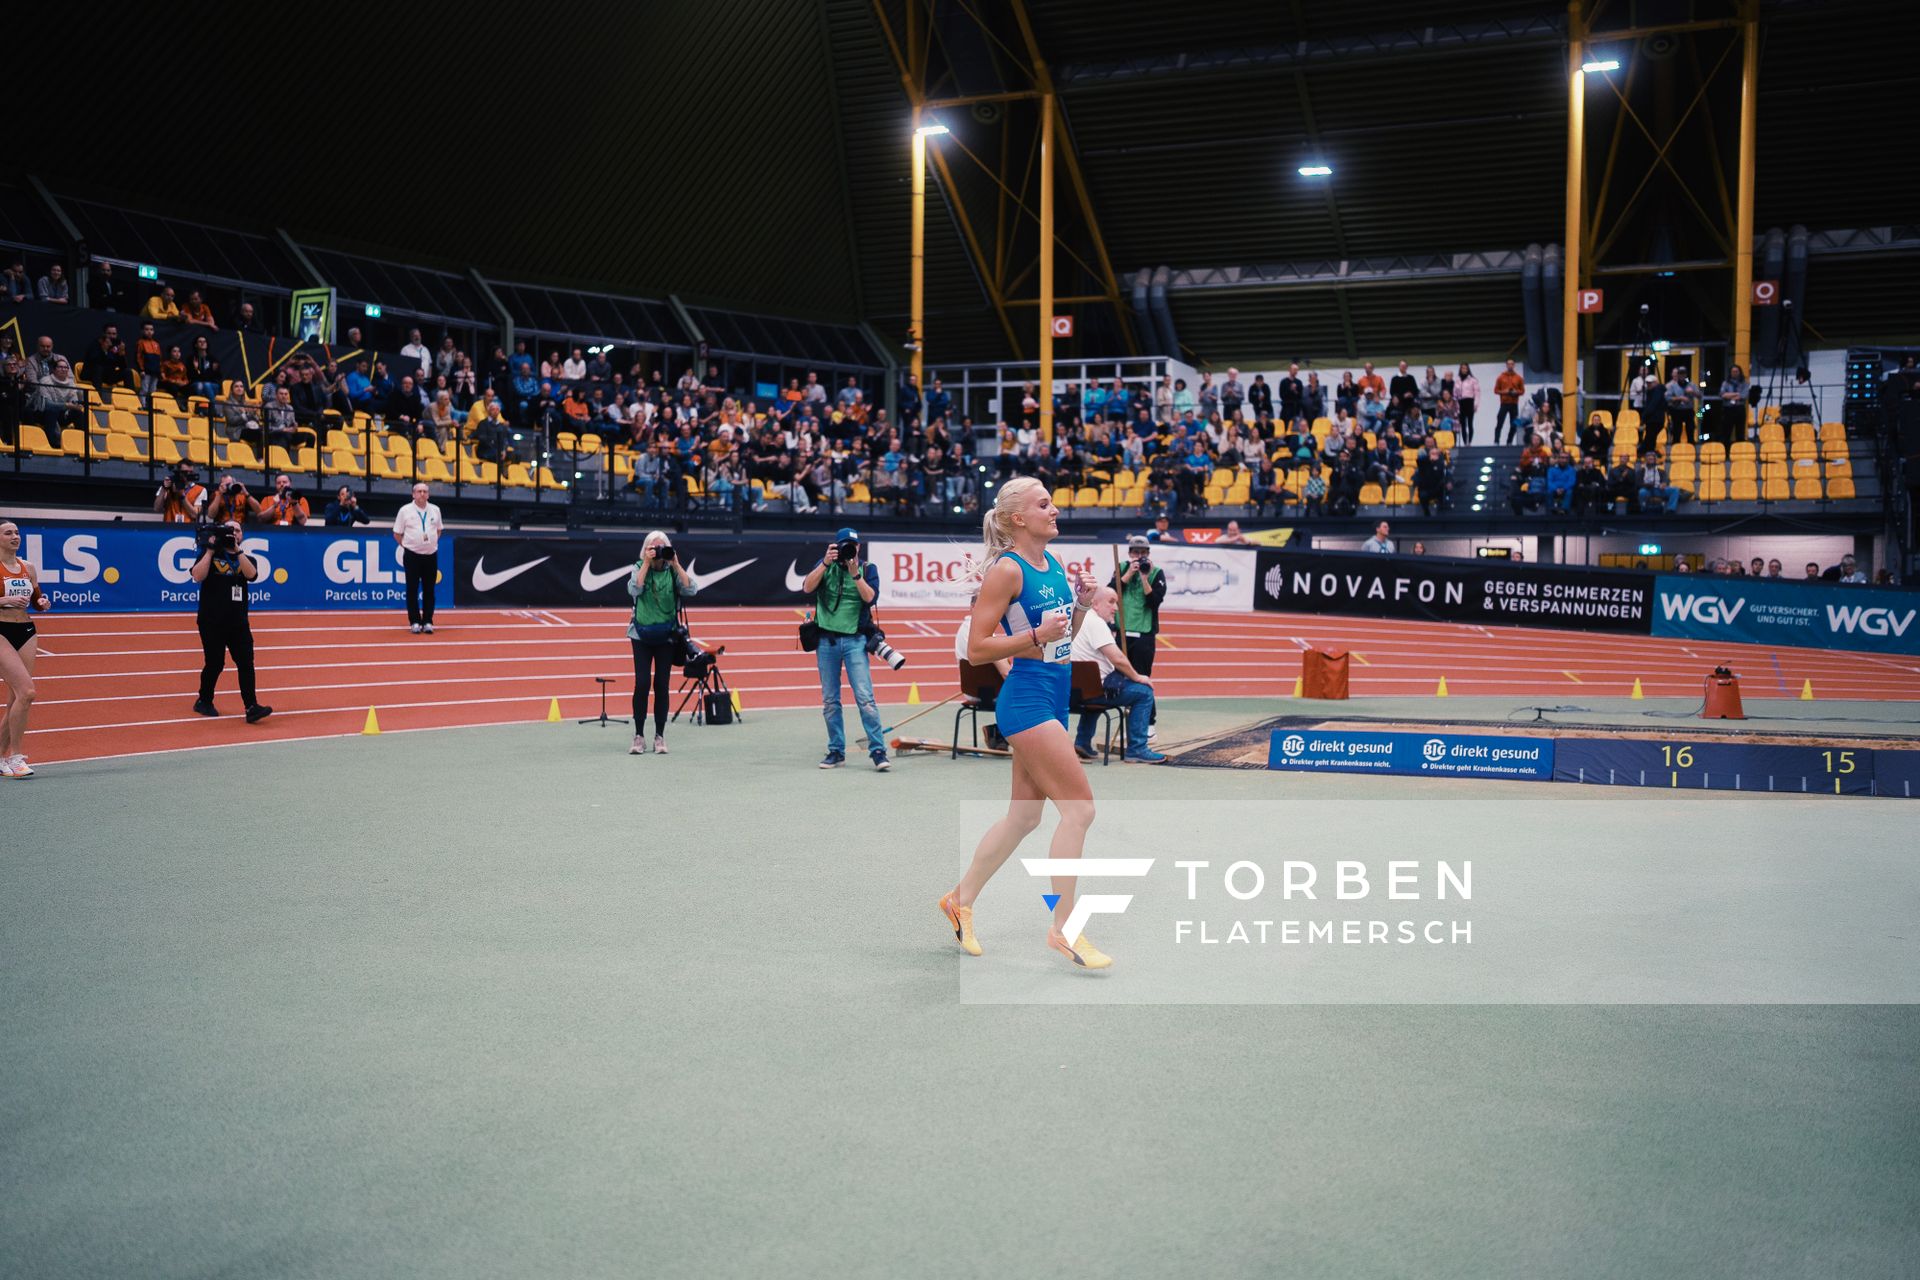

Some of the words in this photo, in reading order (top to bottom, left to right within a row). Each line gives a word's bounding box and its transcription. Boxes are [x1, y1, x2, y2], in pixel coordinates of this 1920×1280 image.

[1756, 282, 1774, 299] O
[1583, 292, 1599, 309] P
[1055, 318, 1070, 334] Q
[11, 579, 26, 587] GLS
[1293, 571, 1464, 604] NOVAFON
[1484, 580, 1538, 597] GEGEN
[1543, 584, 1644, 603] SCHMERZEN
[53, 590, 100, 605] People
[161, 589, 199, 601] Parcel
[325, 589, 368, 600] Parcels
[371, 590, 383, 600] to
[1483, 597, 1494, 610] &
[1499, 597, 1643, 619] VERSPANNUNGEN
[1660, 592, 1746, 625] WGV
[1750, 604, 1767, 613] GUT
[1768, 605, 1820, 617] VERSICHERT.
[1757, 615, 1775, 624] UND
[1776, 616, 1794, 625] GUT
[1795, 617, 1810, 627] IST.
[1826, 604, 1917, 637] WGV
[1282, 738, 1305, 753] BIG
[1309, 740, 1345, 753] direkt
[1348, 742, 1393, 755] gesund
[1423, 743, 1446, 757] BIG
[1451, 745, 1488, 758] direkt
[1492, 748, 1539, 761] gesund
[1315, 759, 1329, 767] geht
[1374, 760, 1391, 768] nicht.
[1661, 745, 1694, 768] 16
[1822, 751, 1855, 774] 15
[1457, 764, 1471, 772] geht
[1473, 765, 1517, 773] Krankenkasse
[1519, 766, 1537, 774] nicht.
